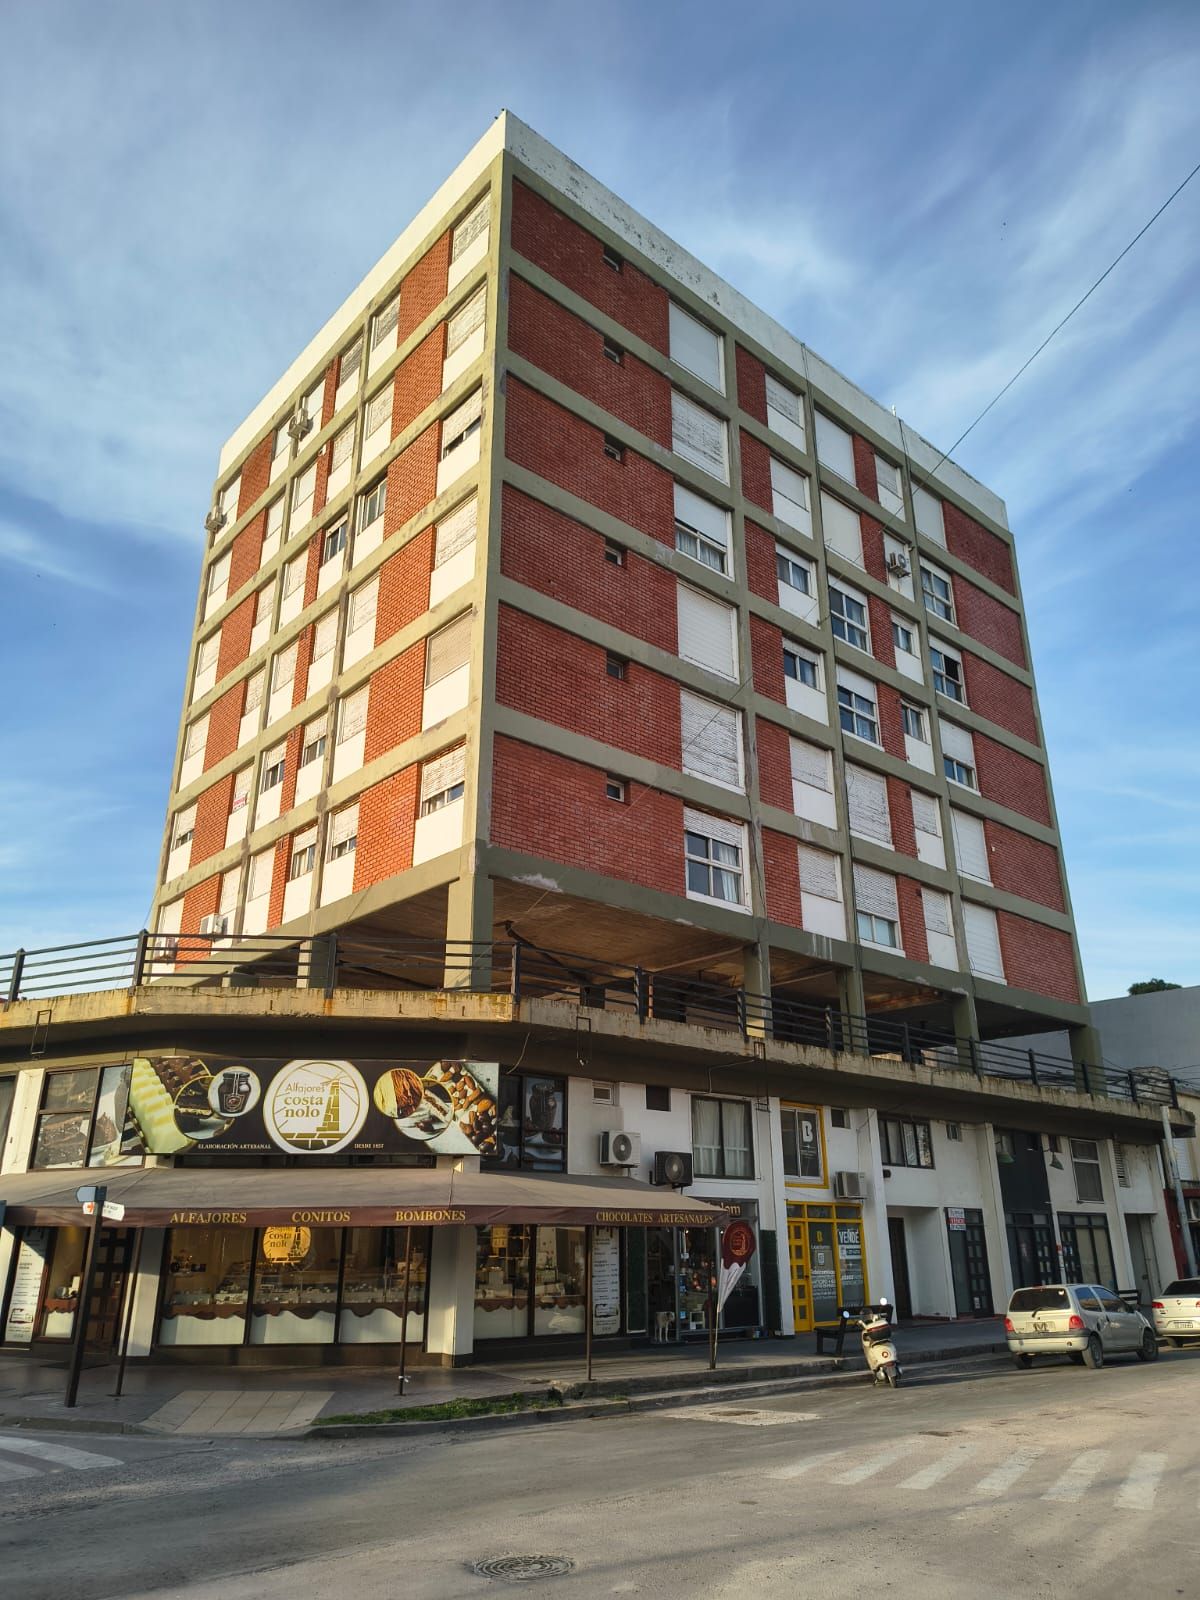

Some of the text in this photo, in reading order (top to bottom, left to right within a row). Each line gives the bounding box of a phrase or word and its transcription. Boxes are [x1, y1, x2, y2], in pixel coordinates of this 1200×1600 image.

[285, 1083, 325, 1097] Alfajores
[284, 1095, 323, 1106] costa
[284, 1106, 320, 1118] nolo
[198, 1142, 239, 1150] ELABORACIÓN
[170, 1210, 466, 1224] ALFAJORES CONITOS BOMBONES
[596, 1212, 714, 1224] CHOCOLATES ARTESANALES
